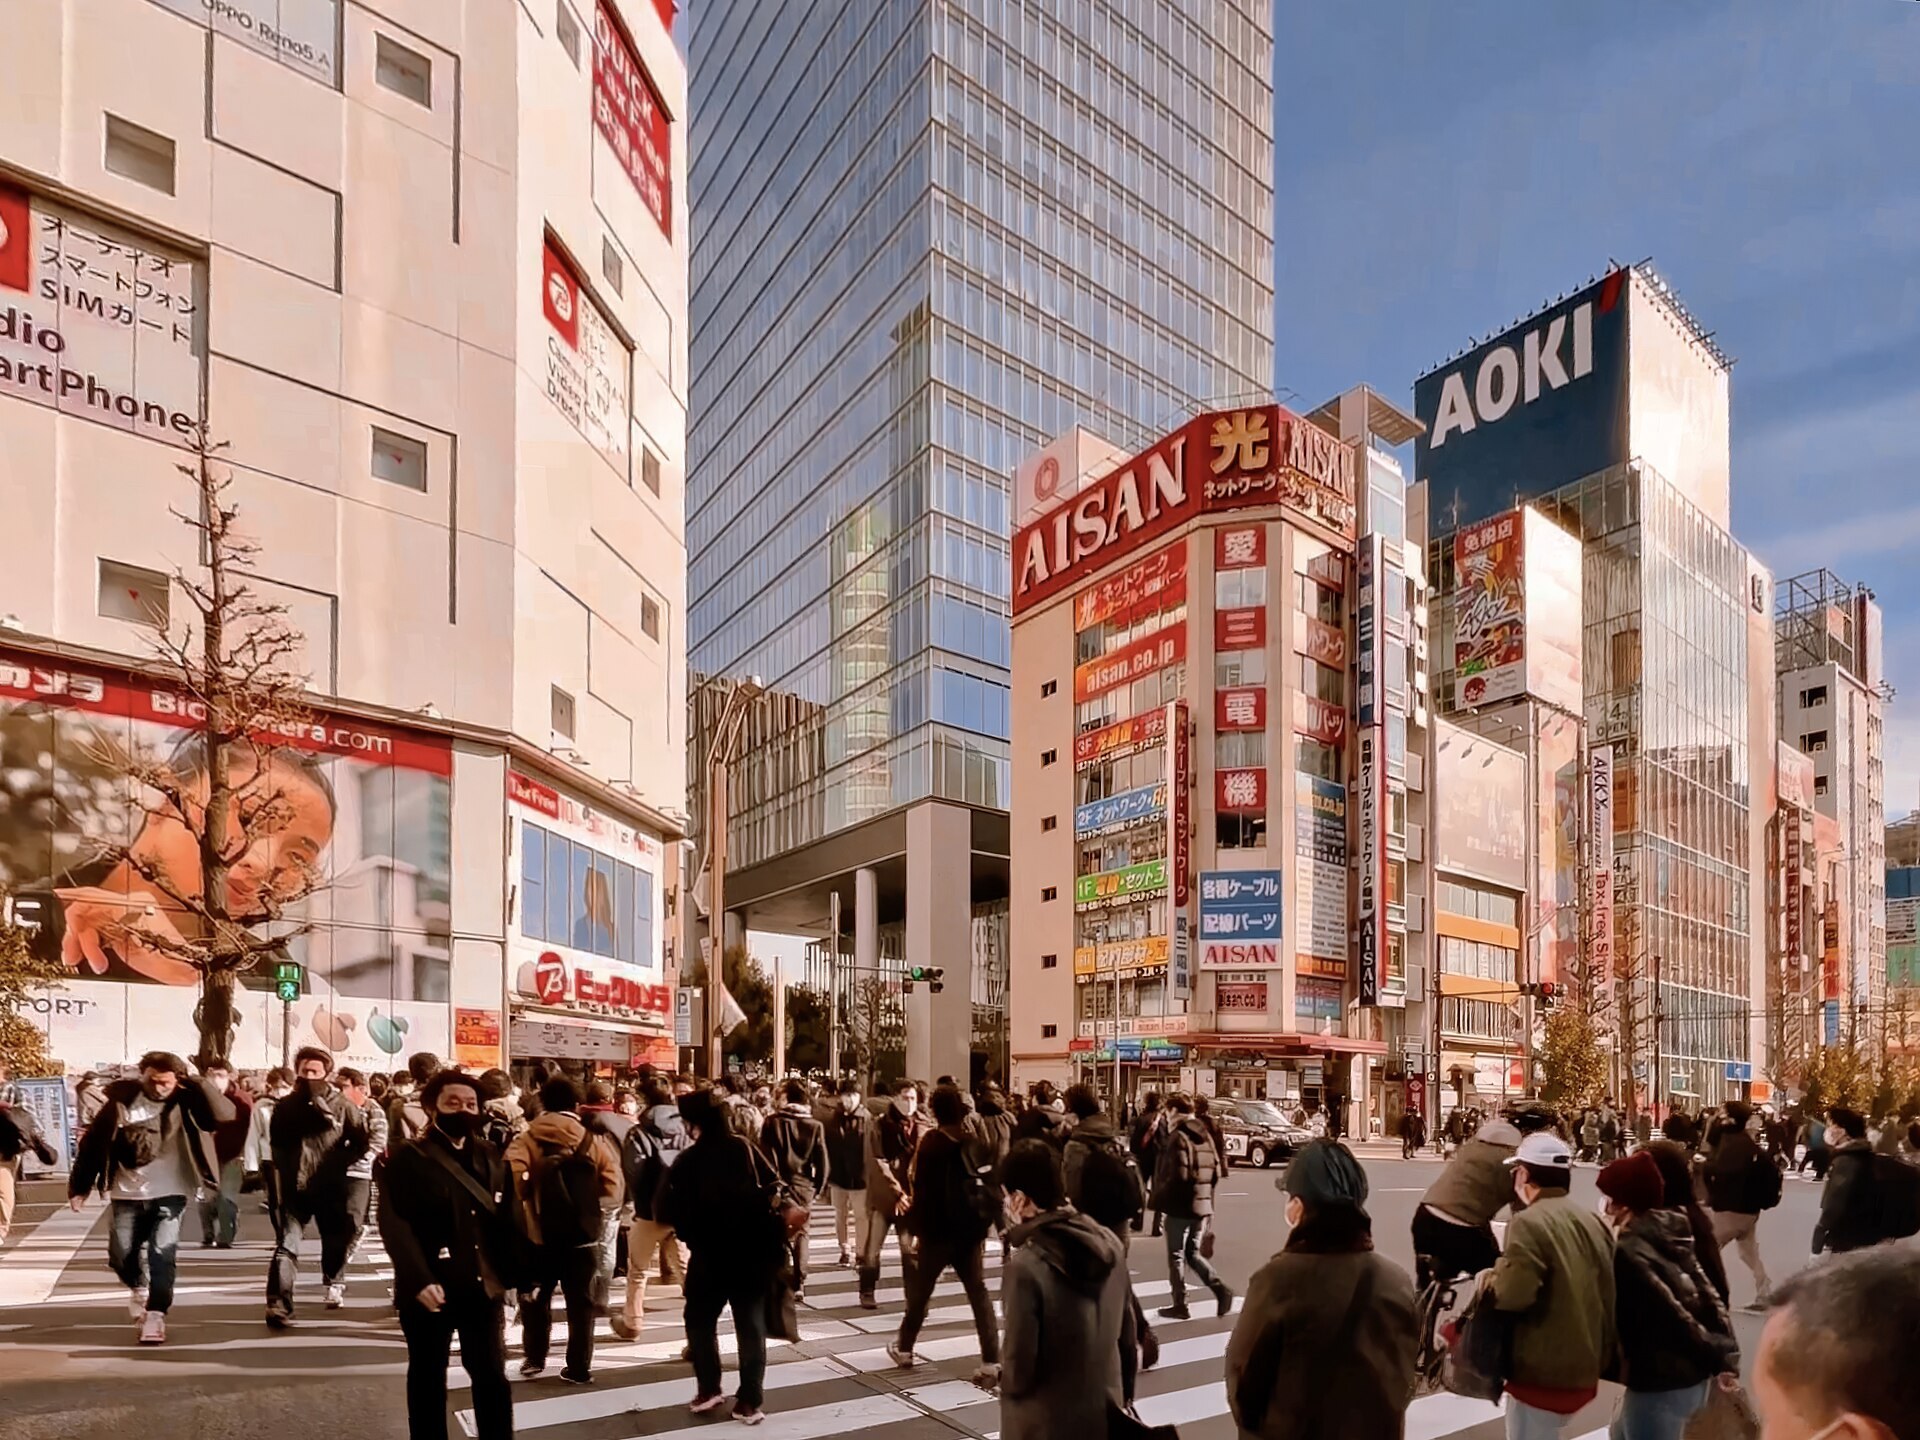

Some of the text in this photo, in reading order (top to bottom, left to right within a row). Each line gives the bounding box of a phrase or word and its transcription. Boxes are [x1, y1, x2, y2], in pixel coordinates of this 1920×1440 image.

[41, 246, 197, 315] スマートフォン
[1430, 300, 1595, 450] AOKI
[1210, 411, 1270, 475] 光
[1017, 435, 1187, 597] AISAN
[1203, 472, 1279, 500] ネットワーク
[151, 692, 392, 755] Bicera.com
[1361, 739, 1373, 911] ケーブル・ネットワーク
[1203, 877, 1279, 900] 各種ケーブル
[1202, 912, 1278, 935] 配線パーツ
[1203, 943, 1277, 965] AISAN
[1362, 922, 1374, 996] AISAN
